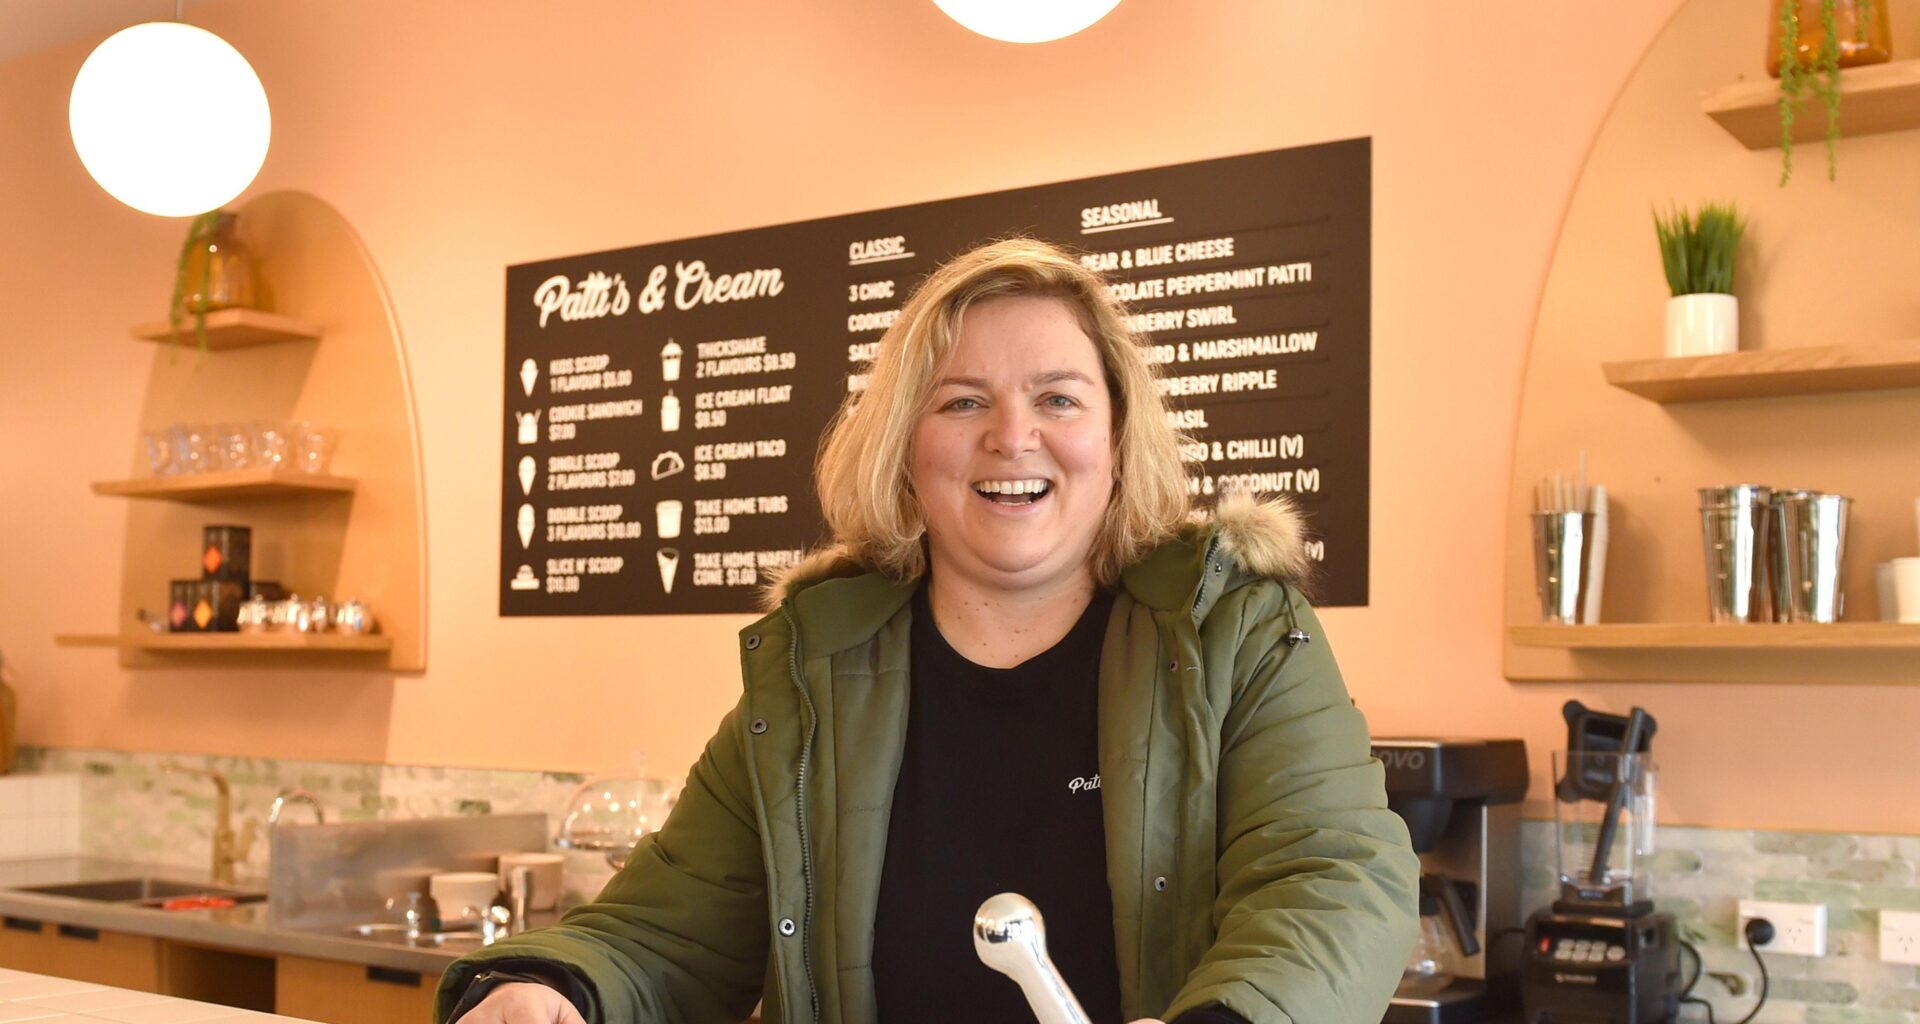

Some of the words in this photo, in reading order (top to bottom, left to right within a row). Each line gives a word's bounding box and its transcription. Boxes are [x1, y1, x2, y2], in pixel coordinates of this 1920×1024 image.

[1081, 199, 1162, 228] SEASONAL
[849, 236, 906, 260] CLASSIC
[1121, 250, 1133, 269] &
[1135, 245, 1173, 267] BLUE
[1175, 237, 1234, 262] CHEESE
[638, 265, 667, 314] &
[674, 260, 784, 310] Cream
[849, 284, 859, 302] 3
[859, 280, 895, 301] CHOC
[1103, 279, 1165, 302] COLATE
[1166, 267, 1265, 297] PEPPERMINT
[1267, 262, 1312, 285] PATTI
[1126, 309, 1185, 334] NBERRY
[1186, 305, 1237, 328] SWIRL
[697, 336, 767, 359] THICKSHAKE
[1177, 343, 1190, 362] &
[1192, 332, 1318, 361] MARSHMALLOW
[575, 354, 610, 374] SCOOP
[696, 361, 704, 378] 2
[705, 355, 762, 377] FLAVOURS
[557, 373, 602, 393] FLAVOUR
[1158, 374, 1219, 397] PBERRY
[1221, 370, 1277, 392] RIPPLE
[695, 392, 715, 410] ICE
[715, 388, 756, 409] CREAM
[756, 385, 793, 405] FLOAT
[549, 404, 586, 423] COOKIE
[586, 399, 643, 420] SANDWICH
[694, 445, 713, 462] ICE
[714, 442, 755, 461] CREAM
[756, 439, 787, 458] TACO
[1211, 441, 1224, 461] &
[1226, 438, 1277, 460] CHILLI
[1279, 434, 1304, 458] (V)
[548, 456, 585, 473] SINGLE
[584, 452, 621, 471] SCOOP
[547, 473, 556, 491] 2
[556, 471, 607, 490] FLAVOURS
[1295, 468, 1320, 493] (V)
[587, 504, 624, 522] SCOOP
[695, 499, 722, 516] TAKE
[722, 498, 757, 515] HOME
[757, 496, 789, 513] TUBS
[555, 523, 606, 541] FLAVOURS
[546, 559, 576, 575] SLICE
[587, 556, 624, 574] SCOOP
[694, 553, 721, 569] TAKE
[721, 551, 757, 568] HOME
[693, 568, 724, 585] CONE
